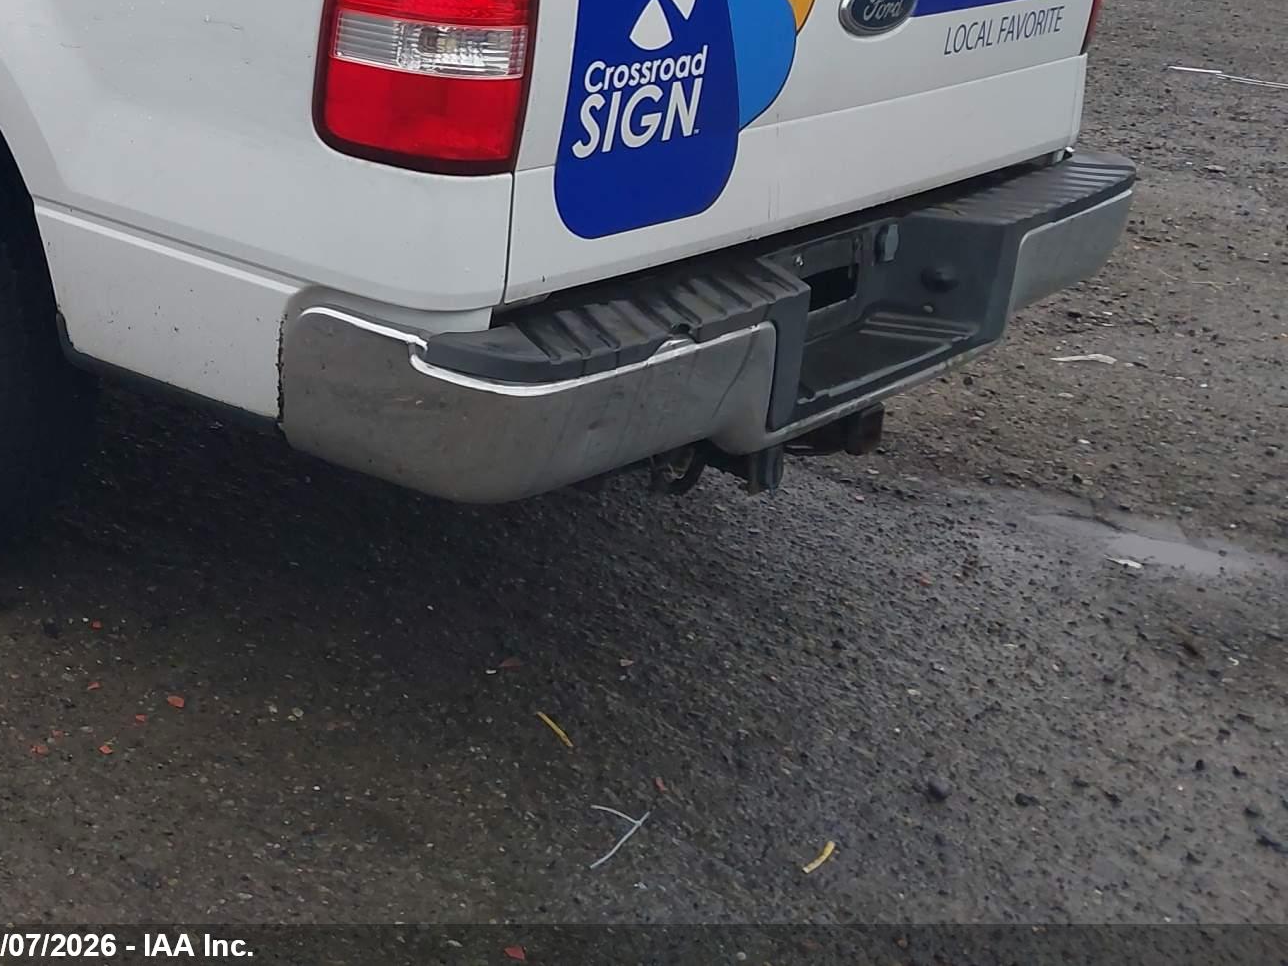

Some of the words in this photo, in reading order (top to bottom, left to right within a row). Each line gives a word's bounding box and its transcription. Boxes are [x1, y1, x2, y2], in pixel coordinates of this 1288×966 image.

[943, 19, 994, 55] LOCAL
[996, 6, 1065, 44] FAVORITE
[584, 44, 709, 93] Crossroad
[571, 77, 703, 159] SIGN
